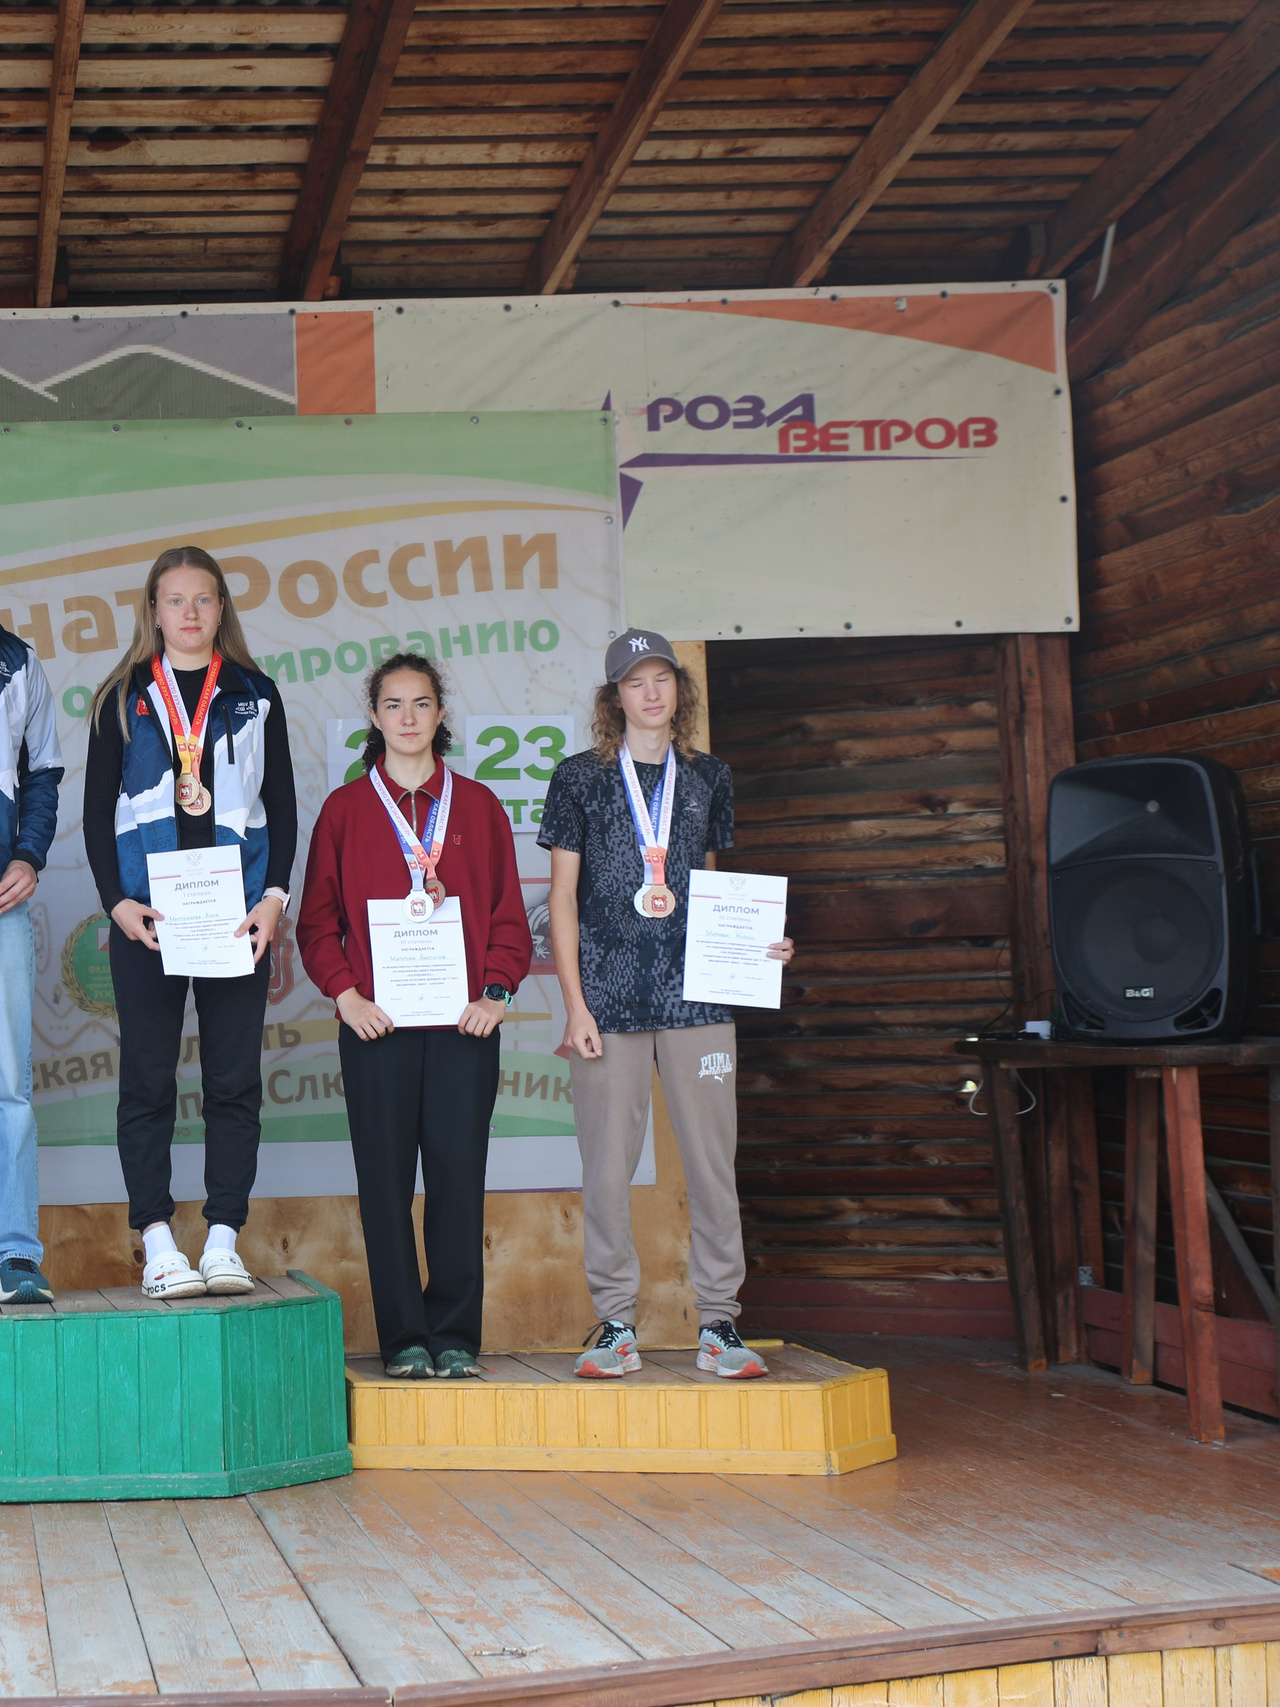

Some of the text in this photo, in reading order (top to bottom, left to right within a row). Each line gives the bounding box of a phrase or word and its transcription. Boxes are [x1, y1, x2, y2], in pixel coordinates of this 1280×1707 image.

[646, 393, 816, 431] РОЗА
[777, 416, 998, 454] ВЕТРОВ
[474, 726, 567, 781] 23
[175, 880, 219, 891] ДИПЛОМ
[713, 904, 759, 915] ДИПЛОМ
[394, 929, 438, 938] ДИПЛОМ
[700, 1052, 733, 1071] PUMA
